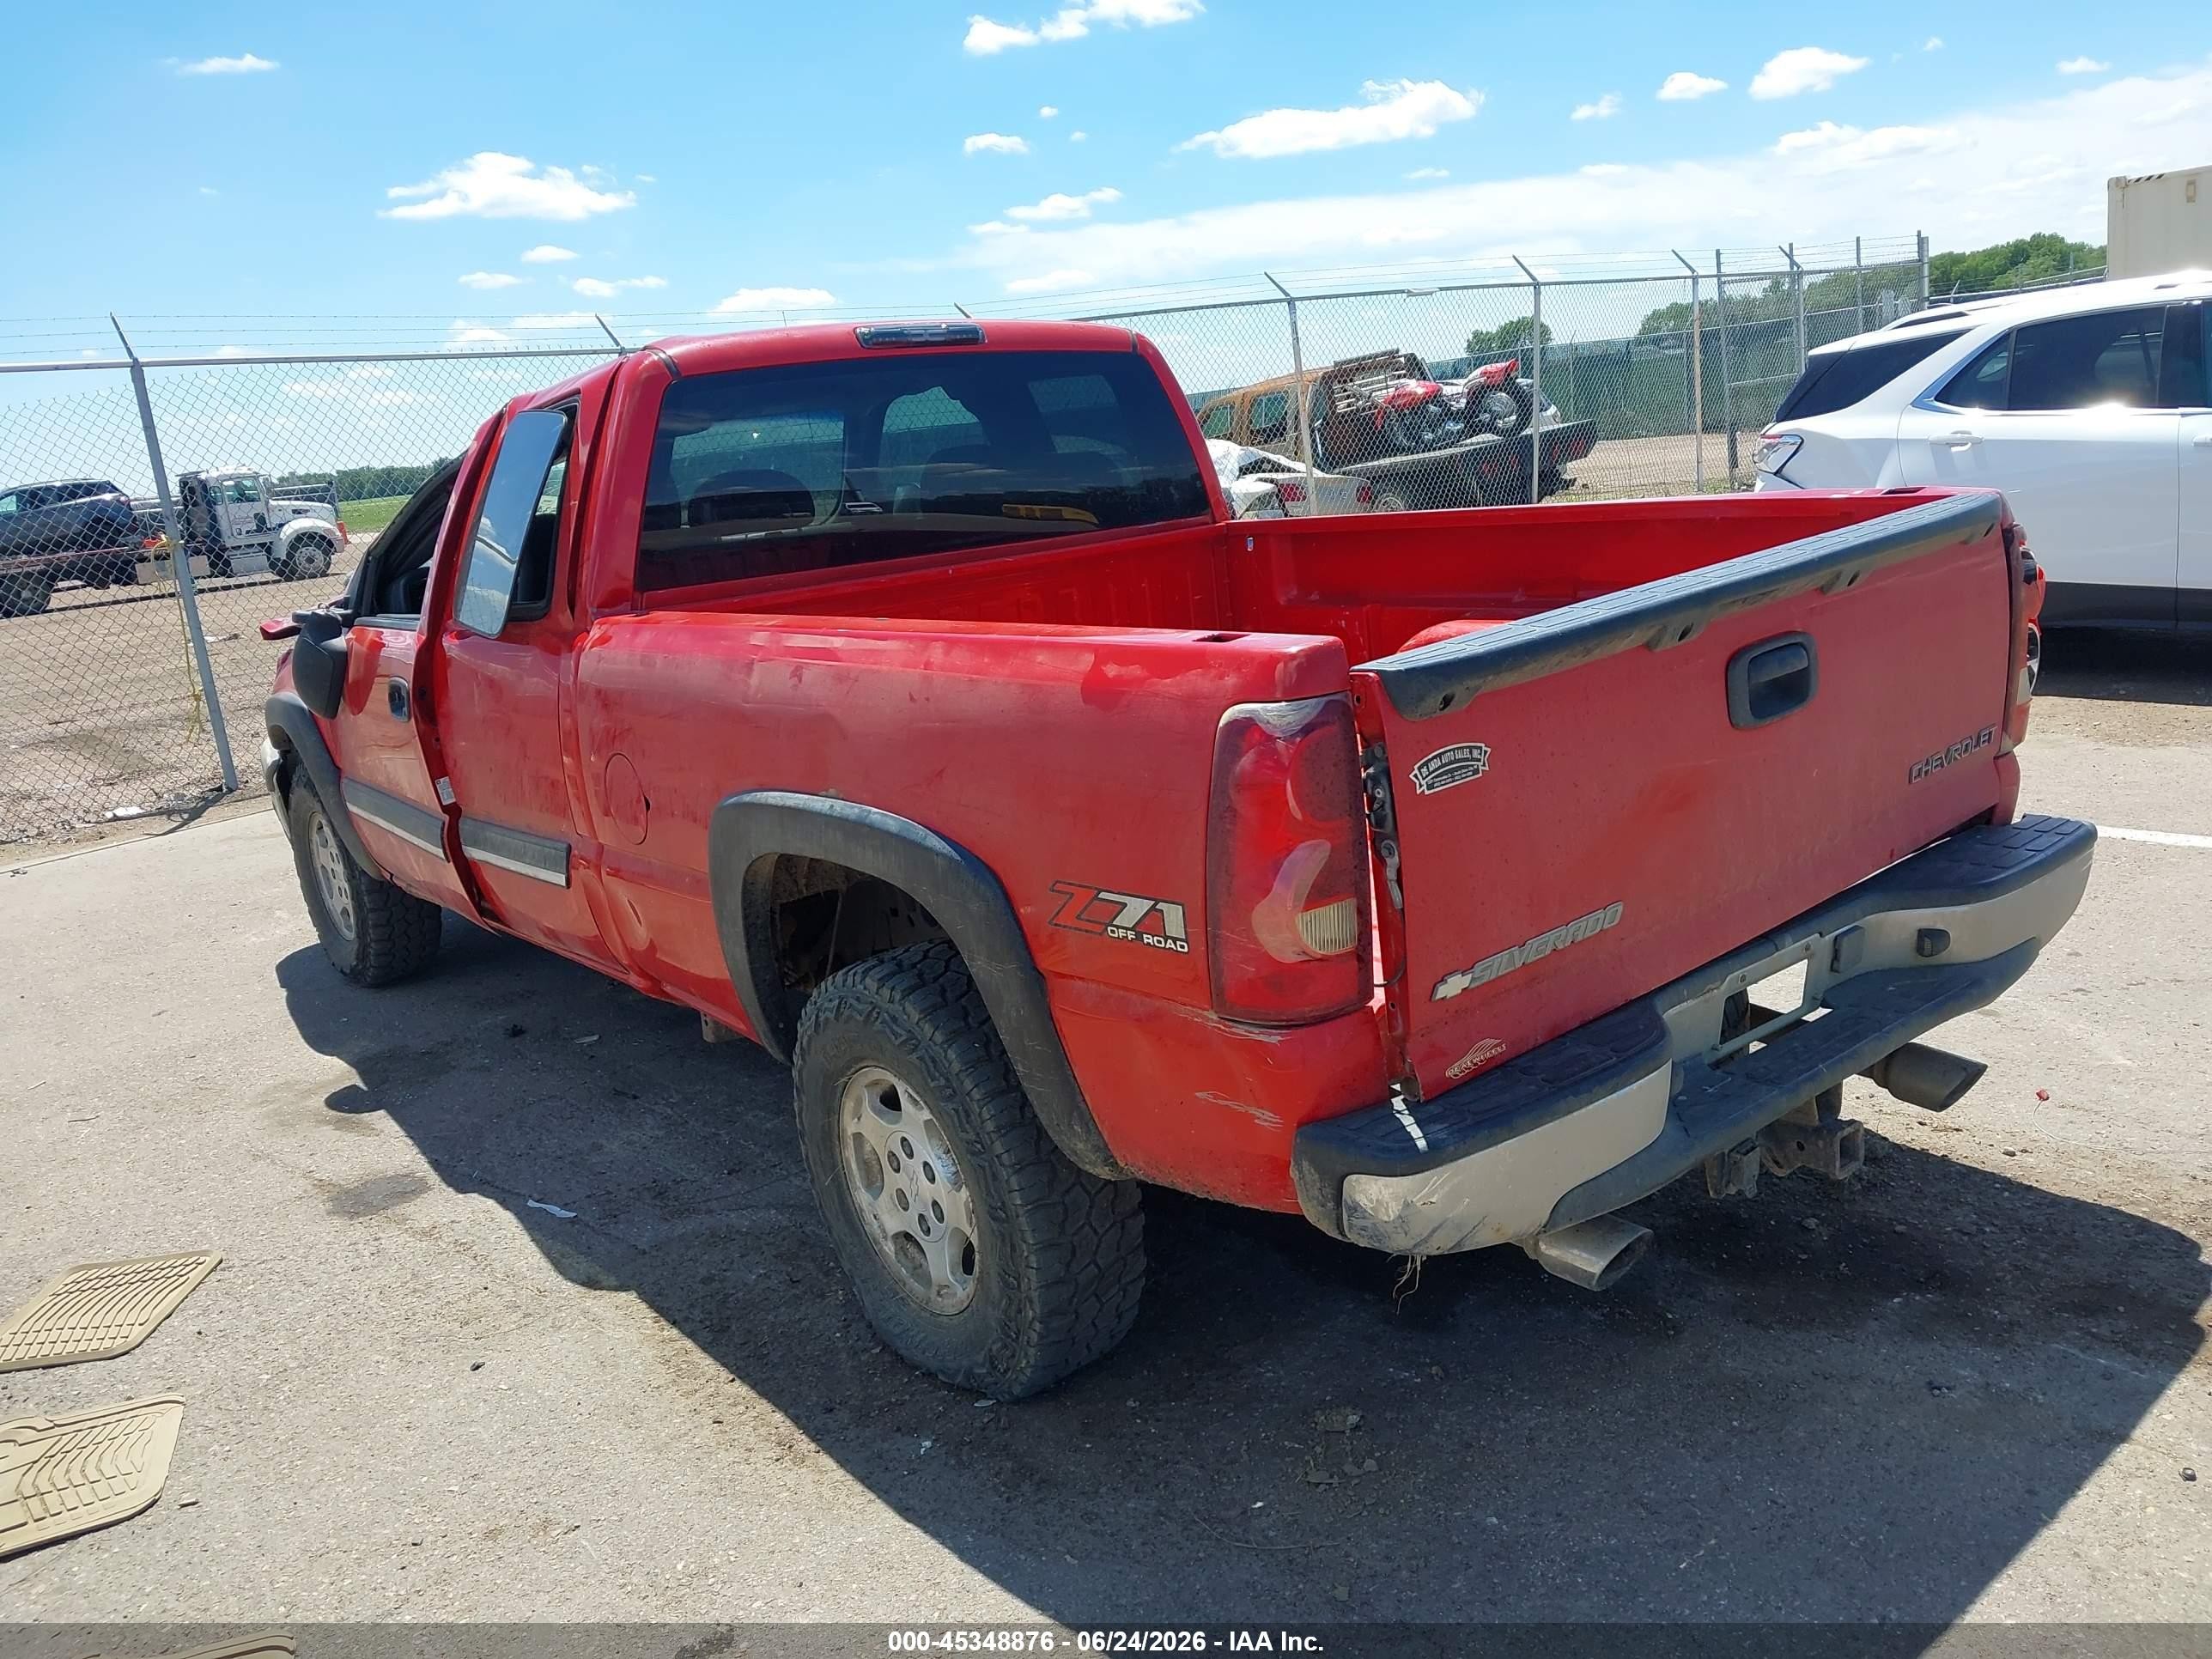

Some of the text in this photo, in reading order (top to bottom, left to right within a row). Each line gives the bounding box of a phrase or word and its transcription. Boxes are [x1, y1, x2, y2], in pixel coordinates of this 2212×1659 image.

[1420, 765, 1429, 778] DE
[1428, 757, 1442, 773] ANDA
[1441, 750, 1455, 764] AUTO
[1455, 748, 1472, 760] SALES,
[1910, 724, 1998, 784] CHEVROLET
[1048, 879, 1188, 941] Z71
[1107, 926, 1189, 954] OFF ROAD
[1468, 900, 1624, 989] SILVERADO
